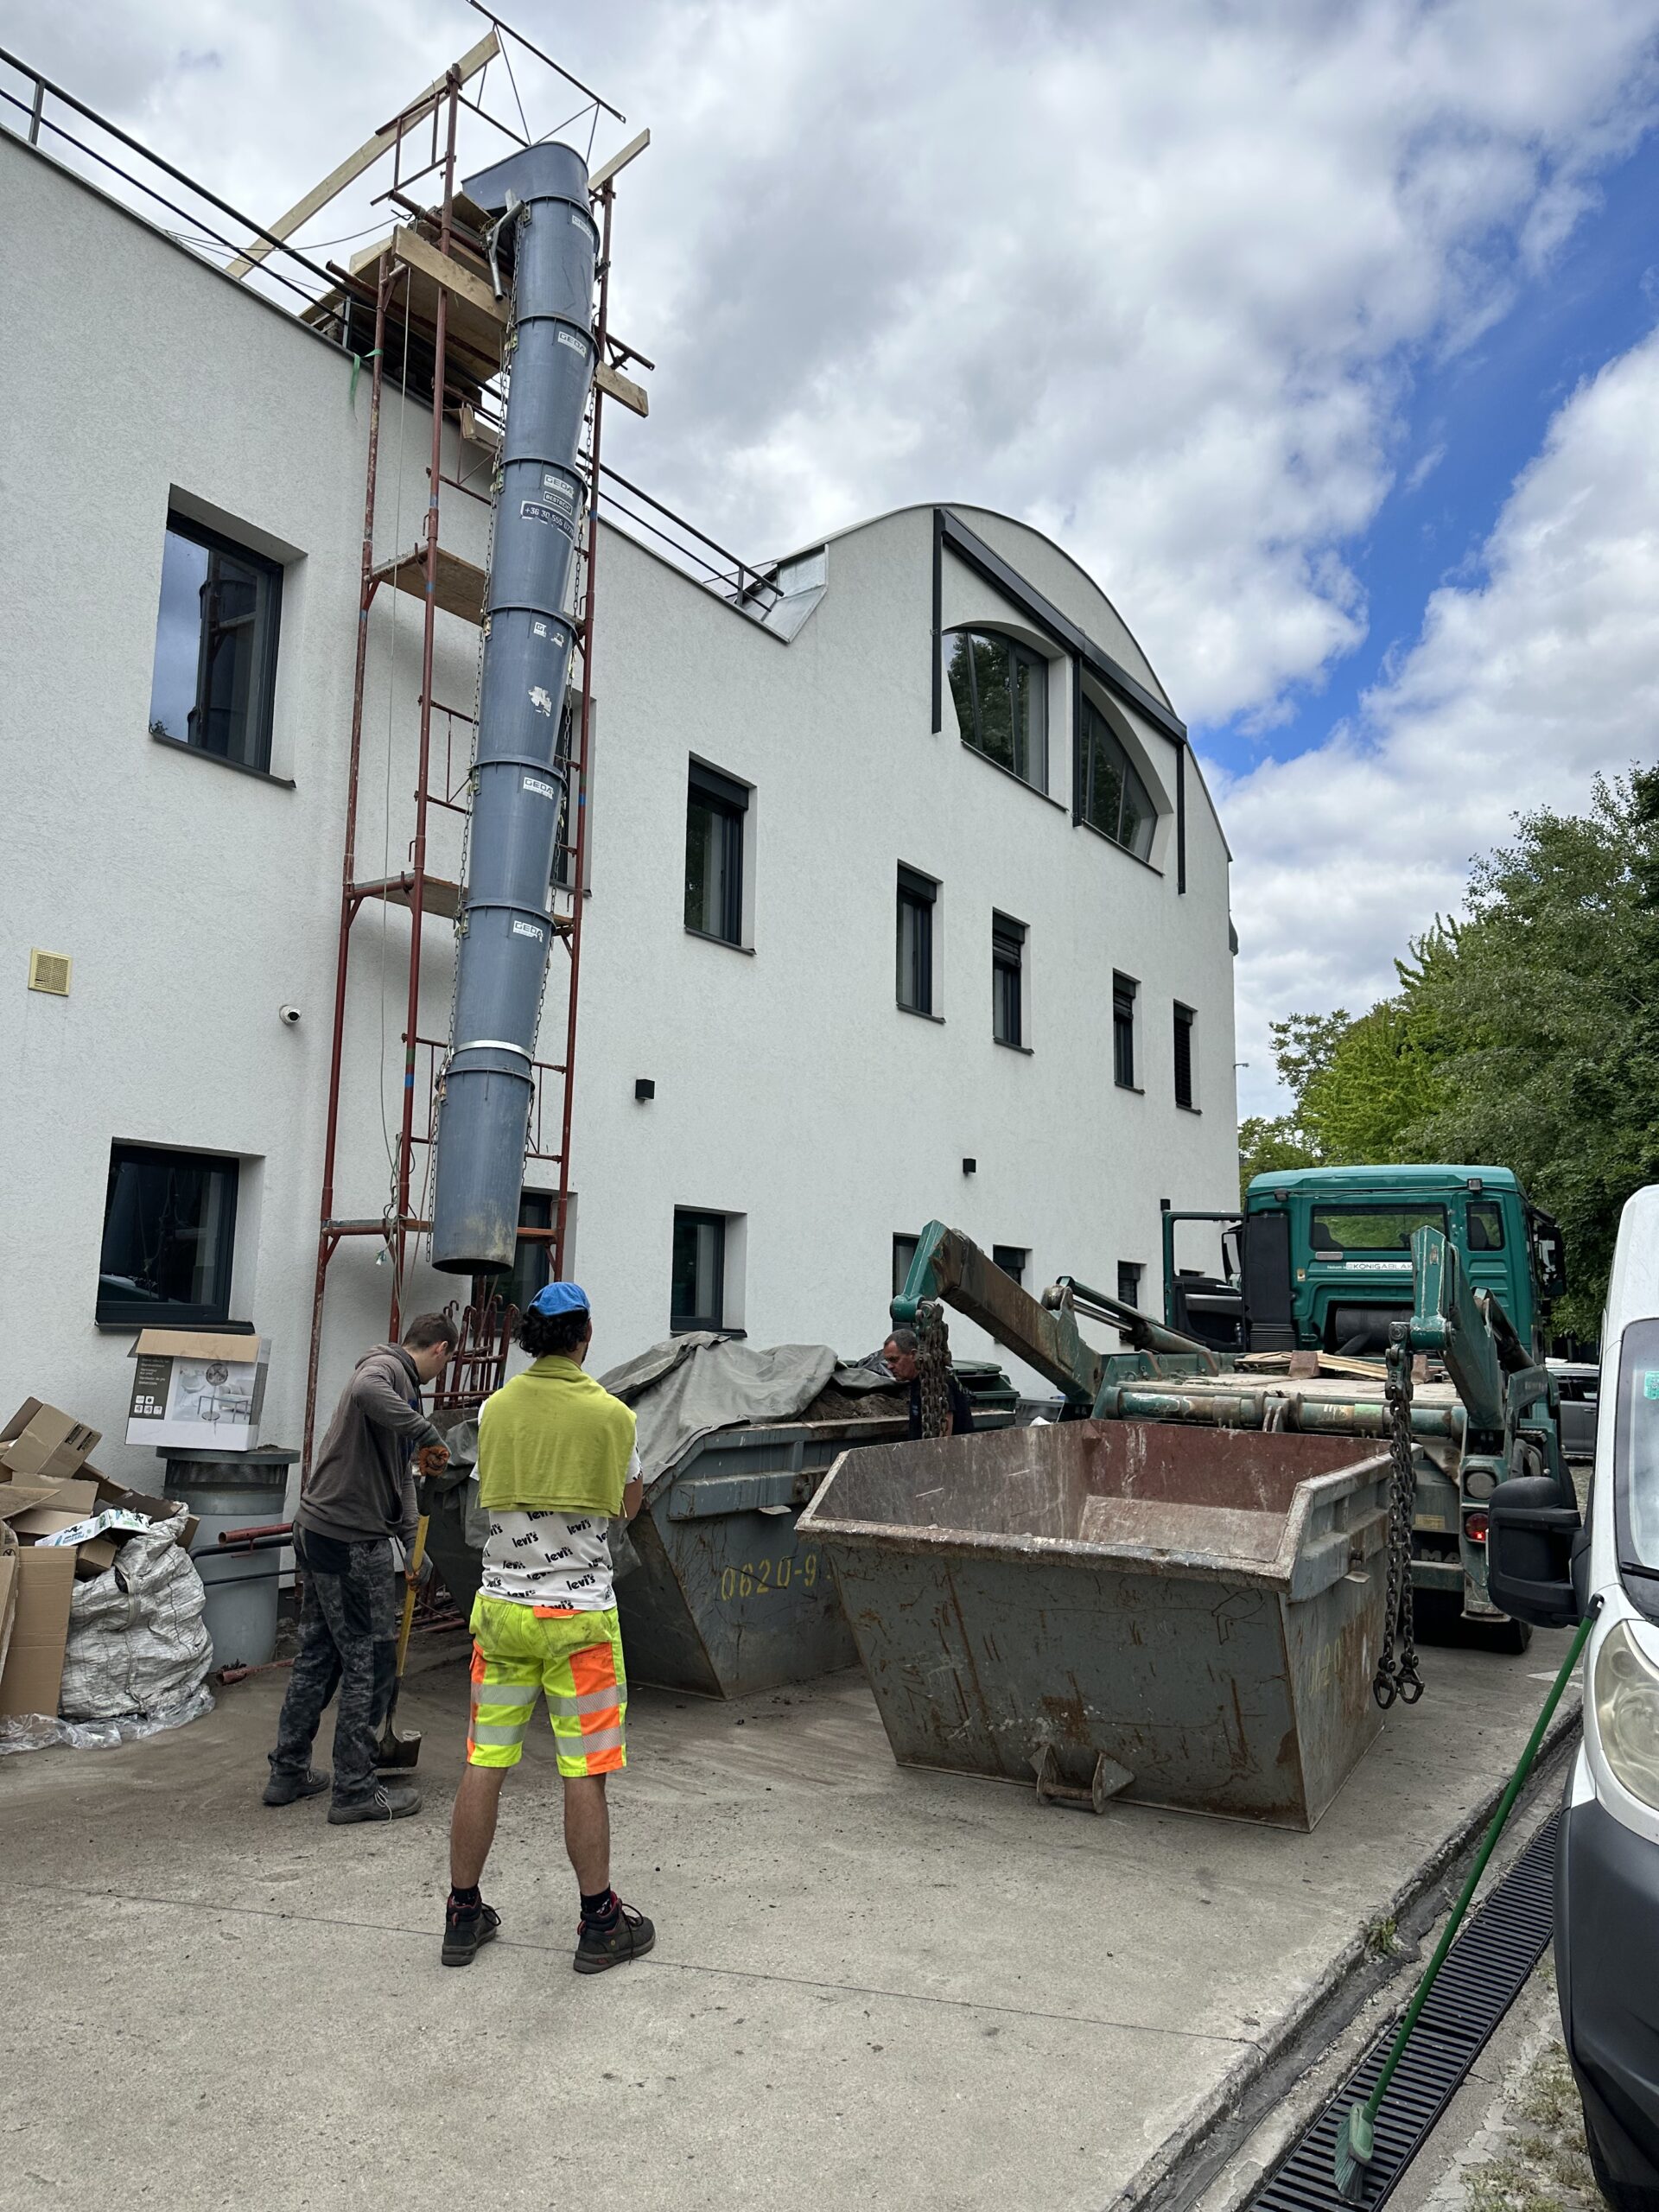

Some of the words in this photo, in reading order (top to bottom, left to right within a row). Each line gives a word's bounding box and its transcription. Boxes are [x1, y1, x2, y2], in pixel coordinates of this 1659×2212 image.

[559, 333, 586, 353] GEDA
[545, 476, 574, 494] GEDA
[545, 493, 571, 512] BESTRENT
[524, 506, 540, 516] +36
[540, 510, 550, 518] 30
[524, 779, 553, 794] GEDA
[515, 922, 543, 938] GEDA
[567, 1518, 592, 1535] levi's
[512, 1531, 539, 1548] levi's
[544, 1546, 574, 1563] levi's
[566, 1573, 596, 1591] levi's
[721, 1554, 817, 1601] 0620-9
